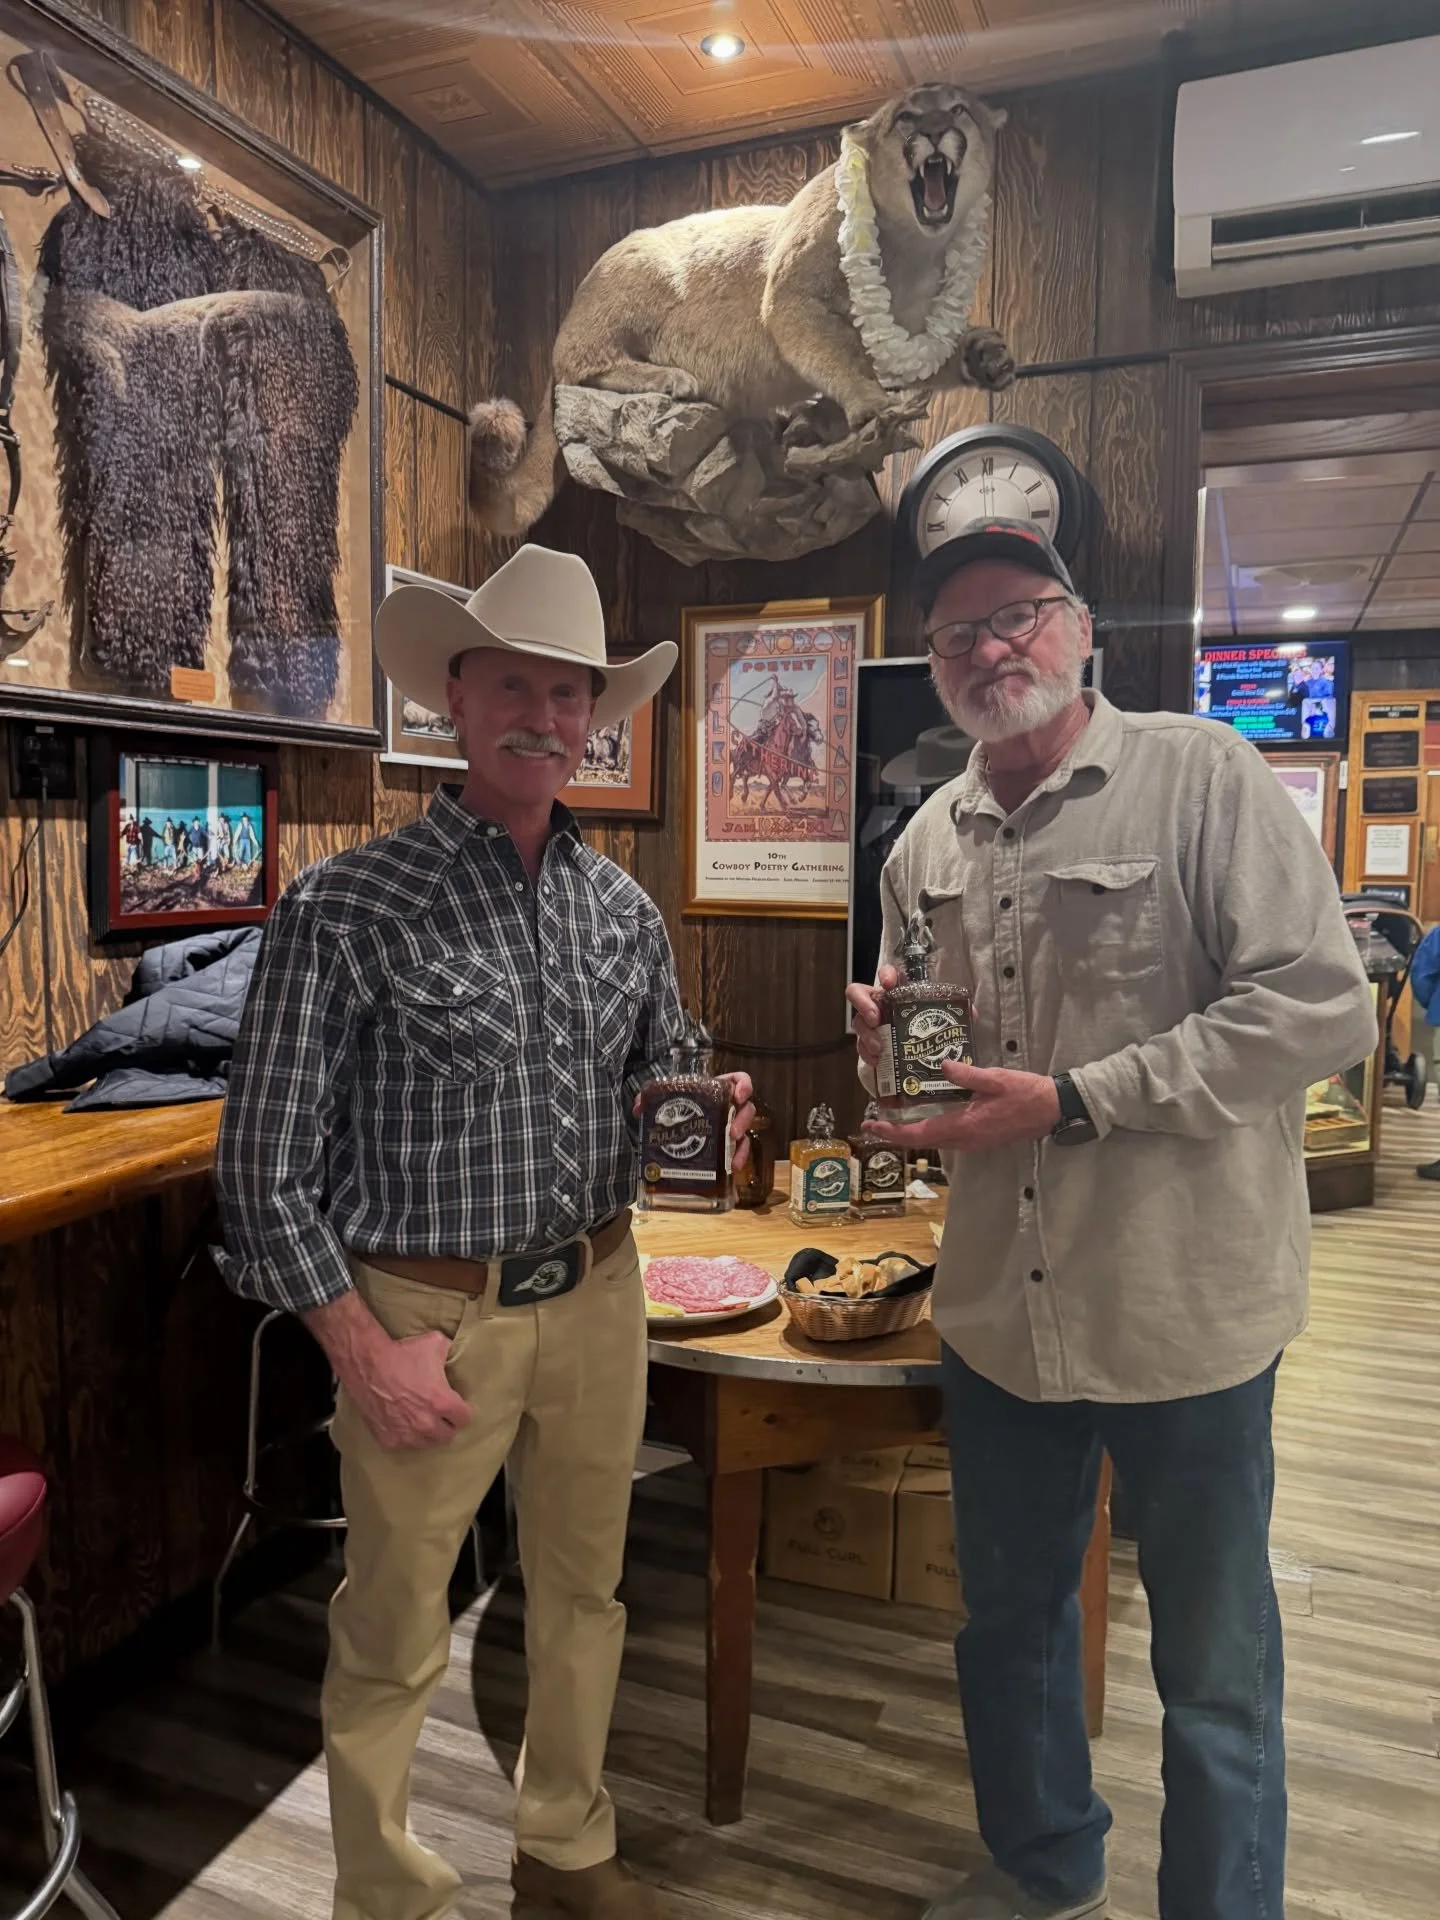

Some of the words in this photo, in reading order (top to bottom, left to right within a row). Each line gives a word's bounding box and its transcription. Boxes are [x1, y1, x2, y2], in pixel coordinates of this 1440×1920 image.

[1205, 650, 1246, 662] DINNER
[1248, 648, 1307, 660] SPECS
[742, 659, 816, 673] POETRY
[712, 861, 751, 870] COWBOY
[754, 861, 788, 871] POETRY
[791, 862, 845, 872] GATHERING
[904, 1040, 933, 1055] FULL
[935, 1026, 967, 1044] CURL
[787, 1539, 820, 1557] FULL
[826, 1548, 867, 1565] CURL
